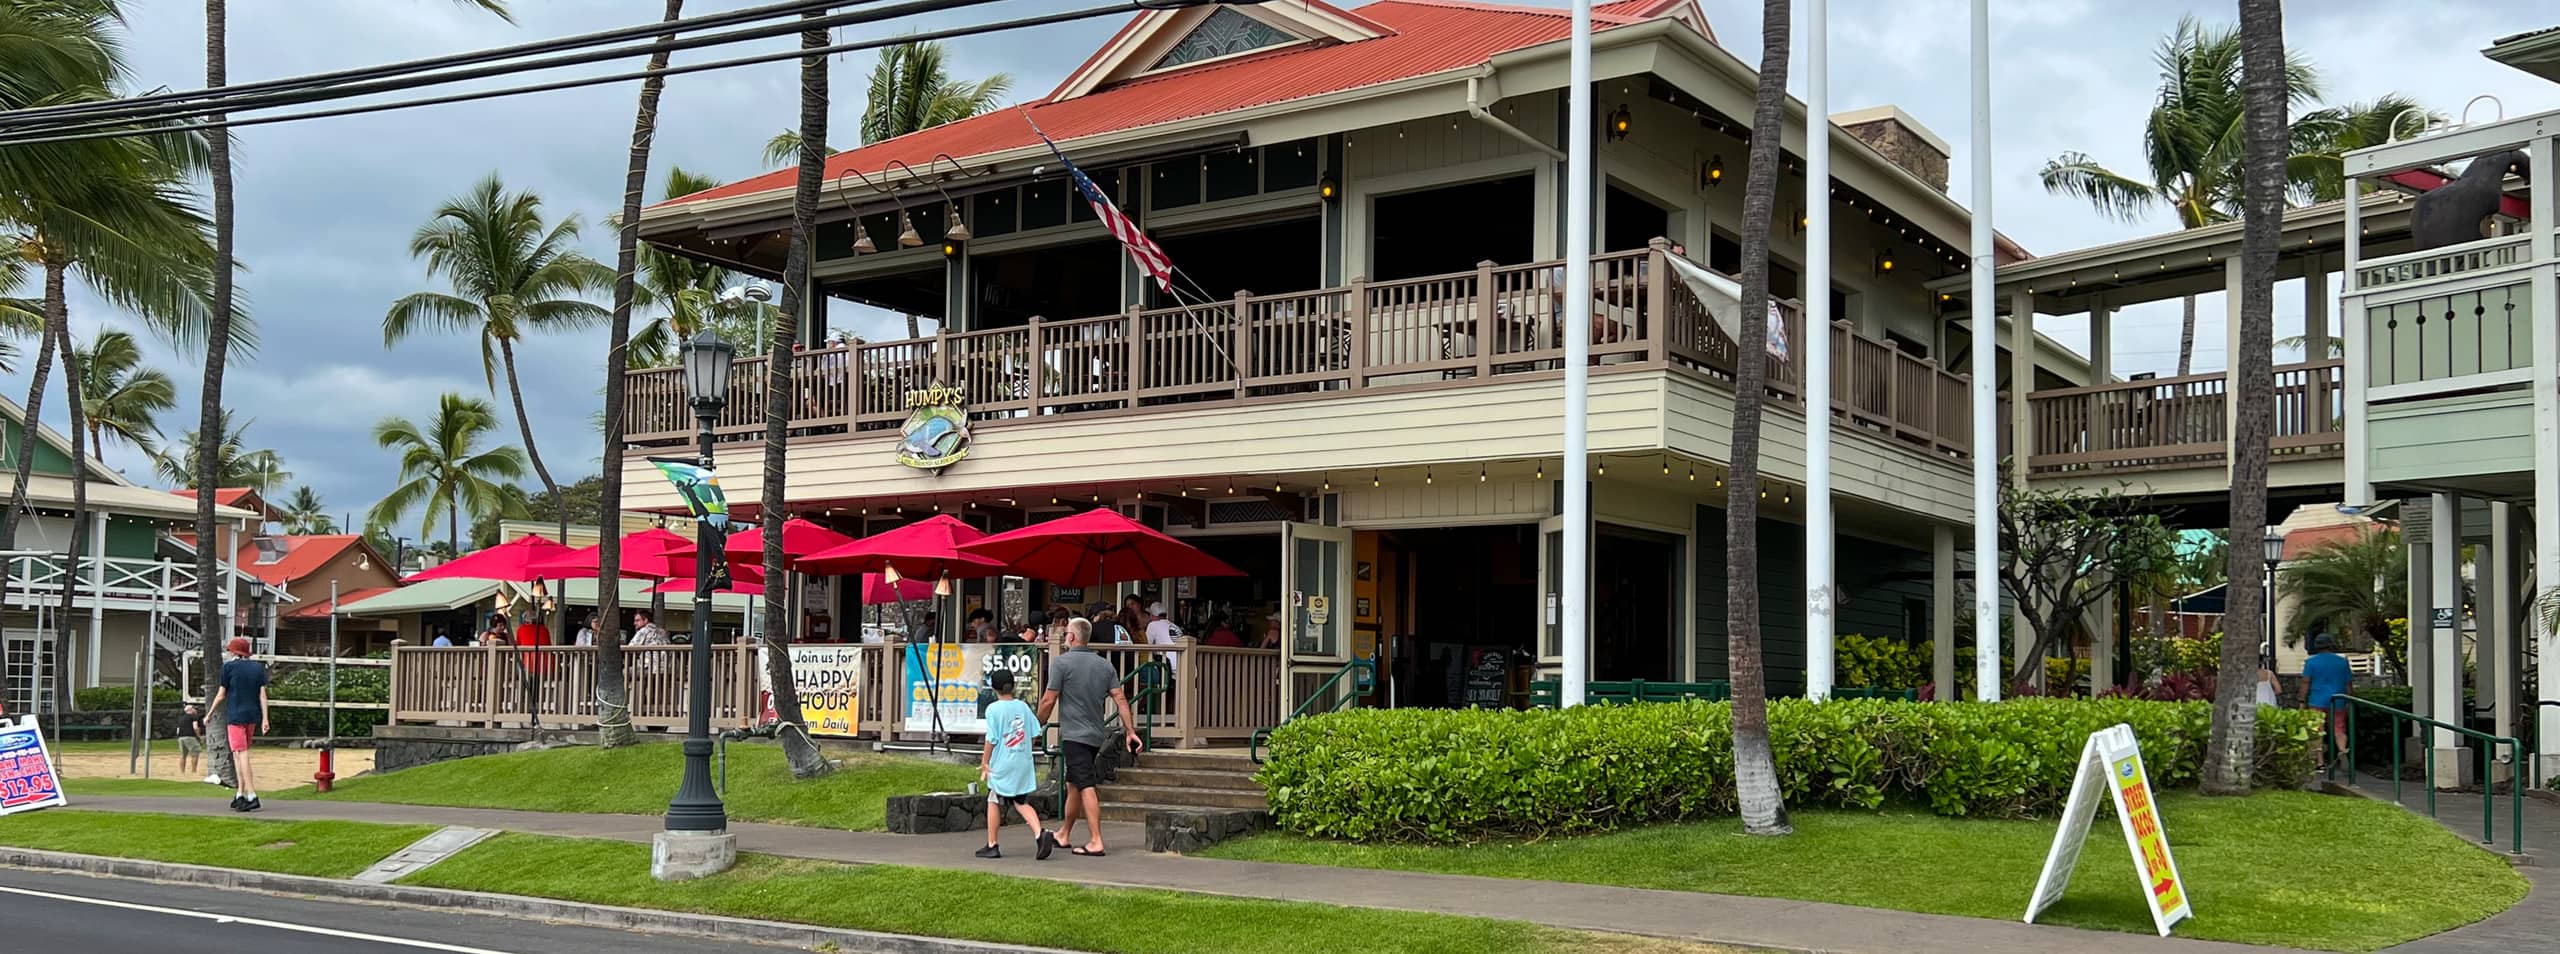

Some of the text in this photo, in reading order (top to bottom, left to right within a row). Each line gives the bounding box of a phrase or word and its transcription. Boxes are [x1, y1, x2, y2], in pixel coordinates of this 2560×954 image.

[905, 387, 965, 408] HUMPY'S
[795, 649, 852, 667] Join us for
[933, 649, 958, 659] HGH
[982, 654, 1032, 674] $5.00
[795, 670, 853, 688] HAPPY
[800, 692, 849, 711] HOUR
[823, 717, 849, 733] Daily
[19, 755, 43, 766] MAHI
[21, 764, 48, 777] CHIPS
[0, 774, 53, 799] $12.95
